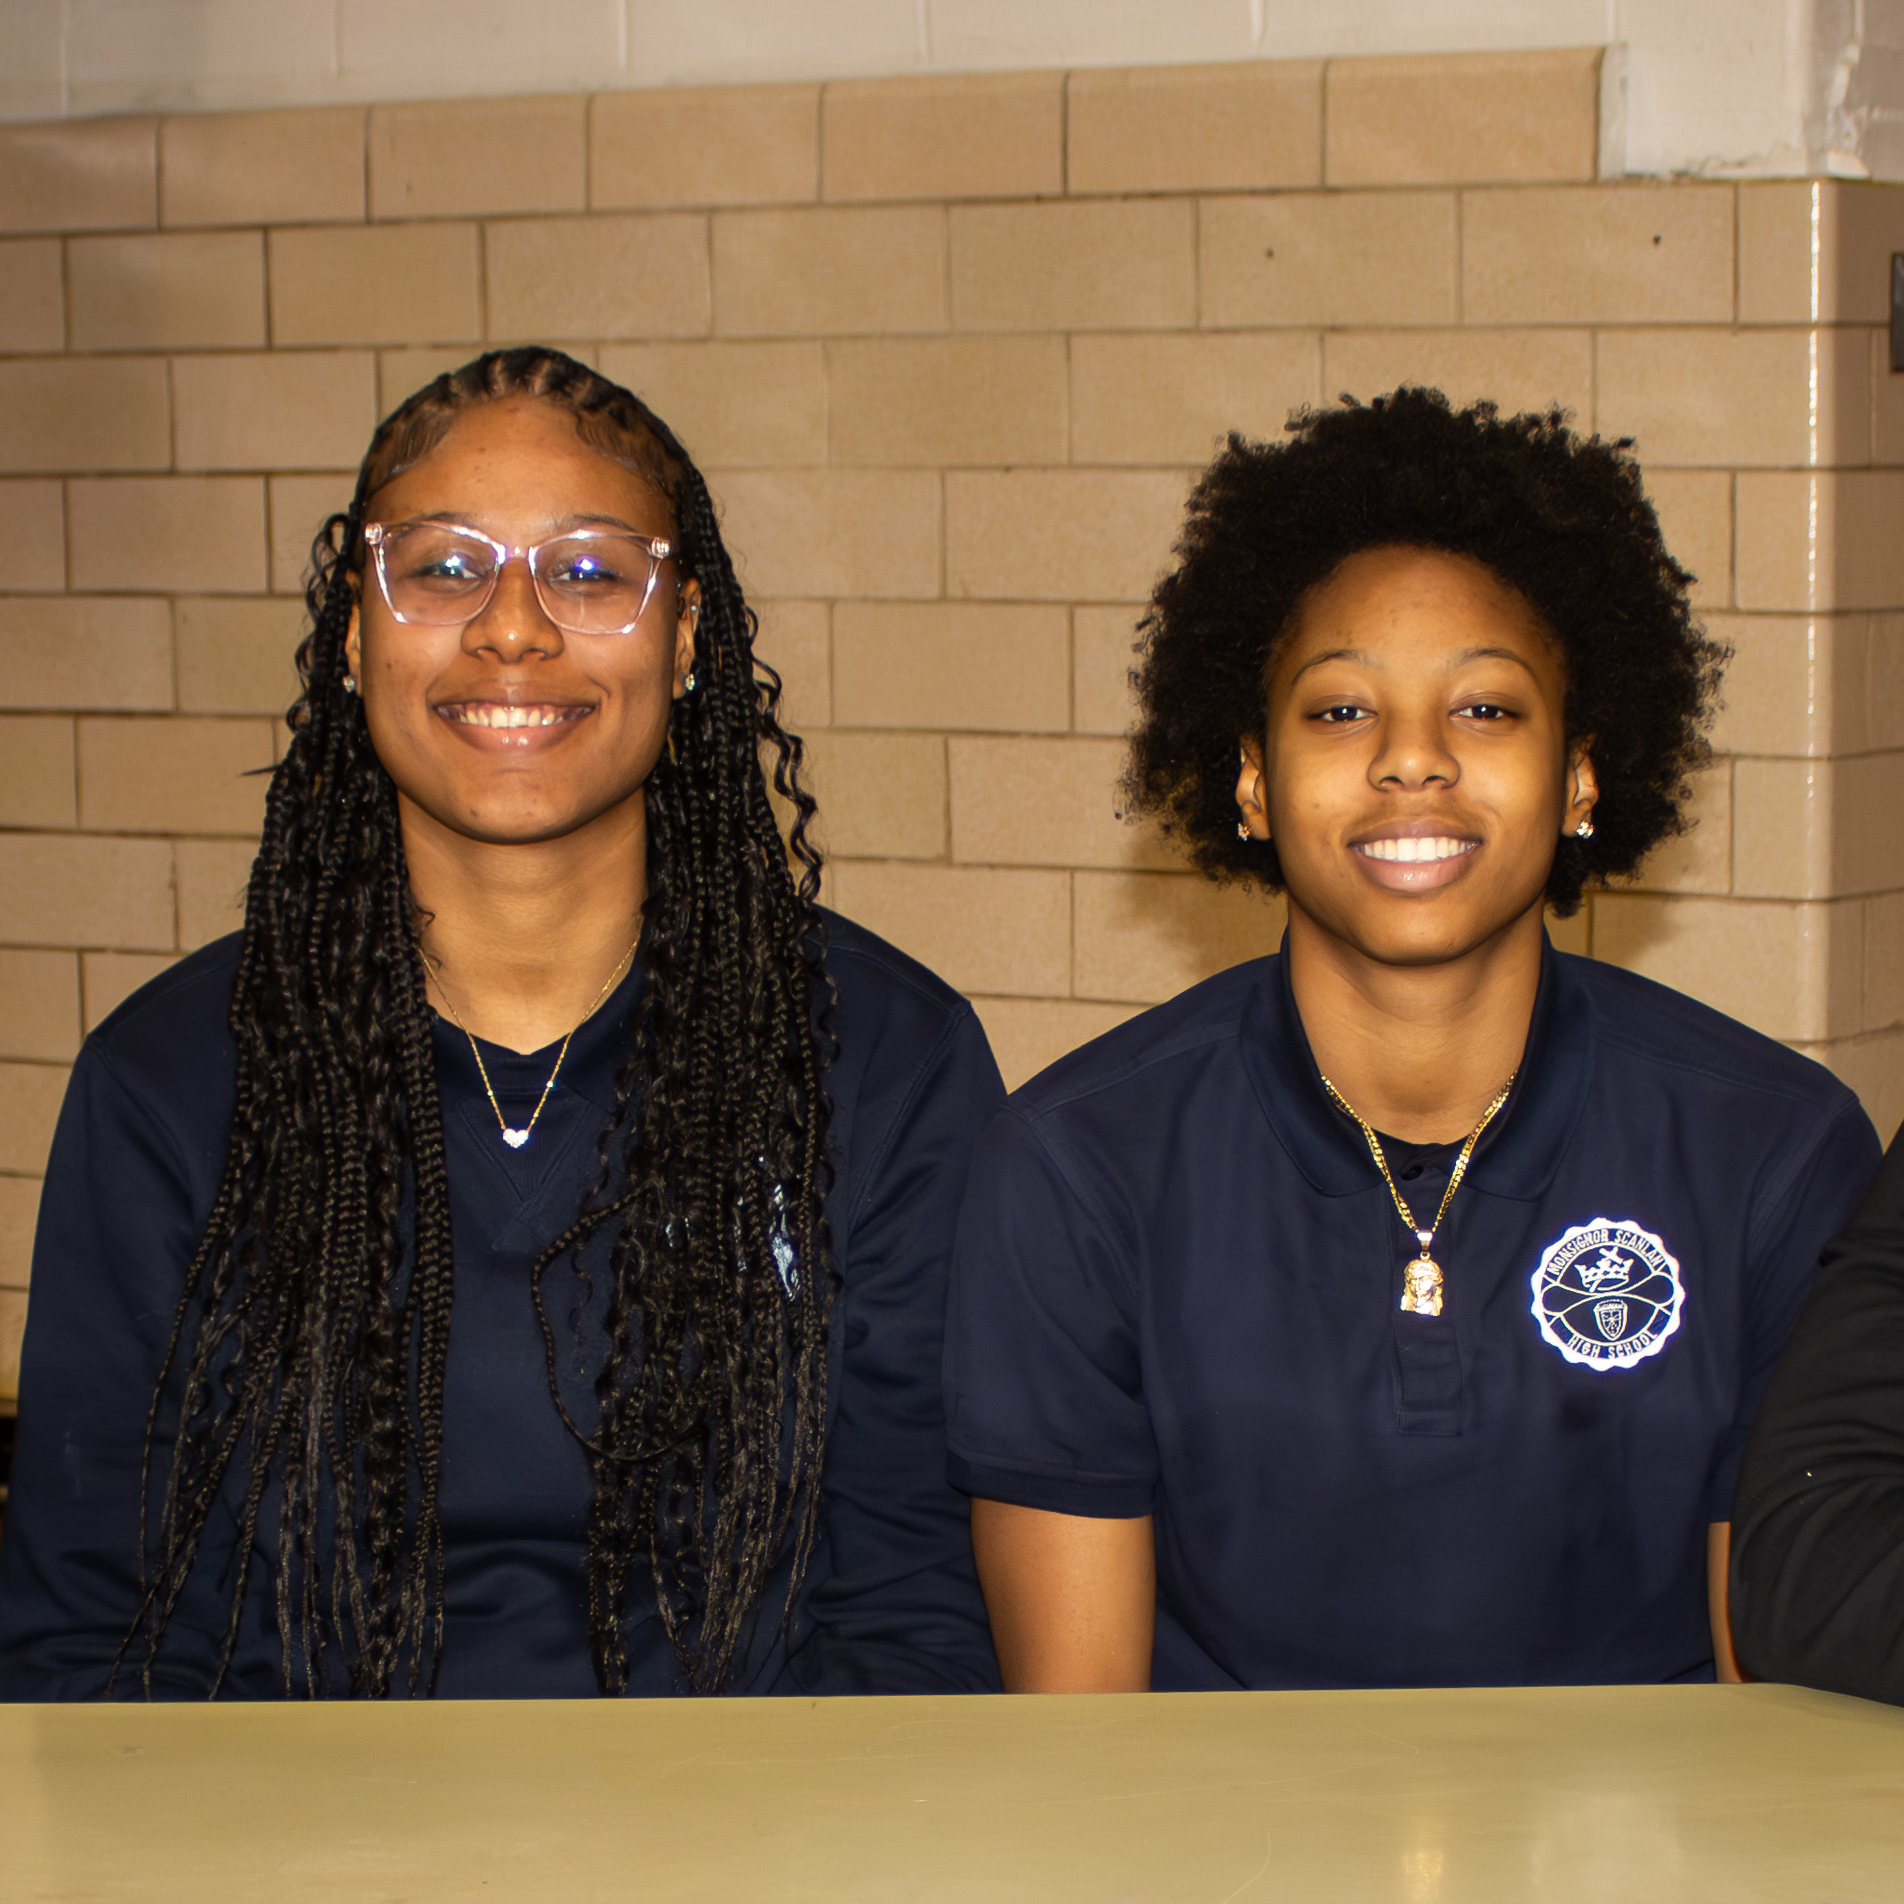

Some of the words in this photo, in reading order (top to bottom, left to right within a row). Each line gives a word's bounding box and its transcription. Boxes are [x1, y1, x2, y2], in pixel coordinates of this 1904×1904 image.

[1547, 1228, 1609, 1276] MONSIGNOR
[1614, 1229, 1665, 1267] SCANLAN
[1567, 1334, 1600, 1359] HIGH
[1608, 1331, 1658, 1360] SCHOOL
